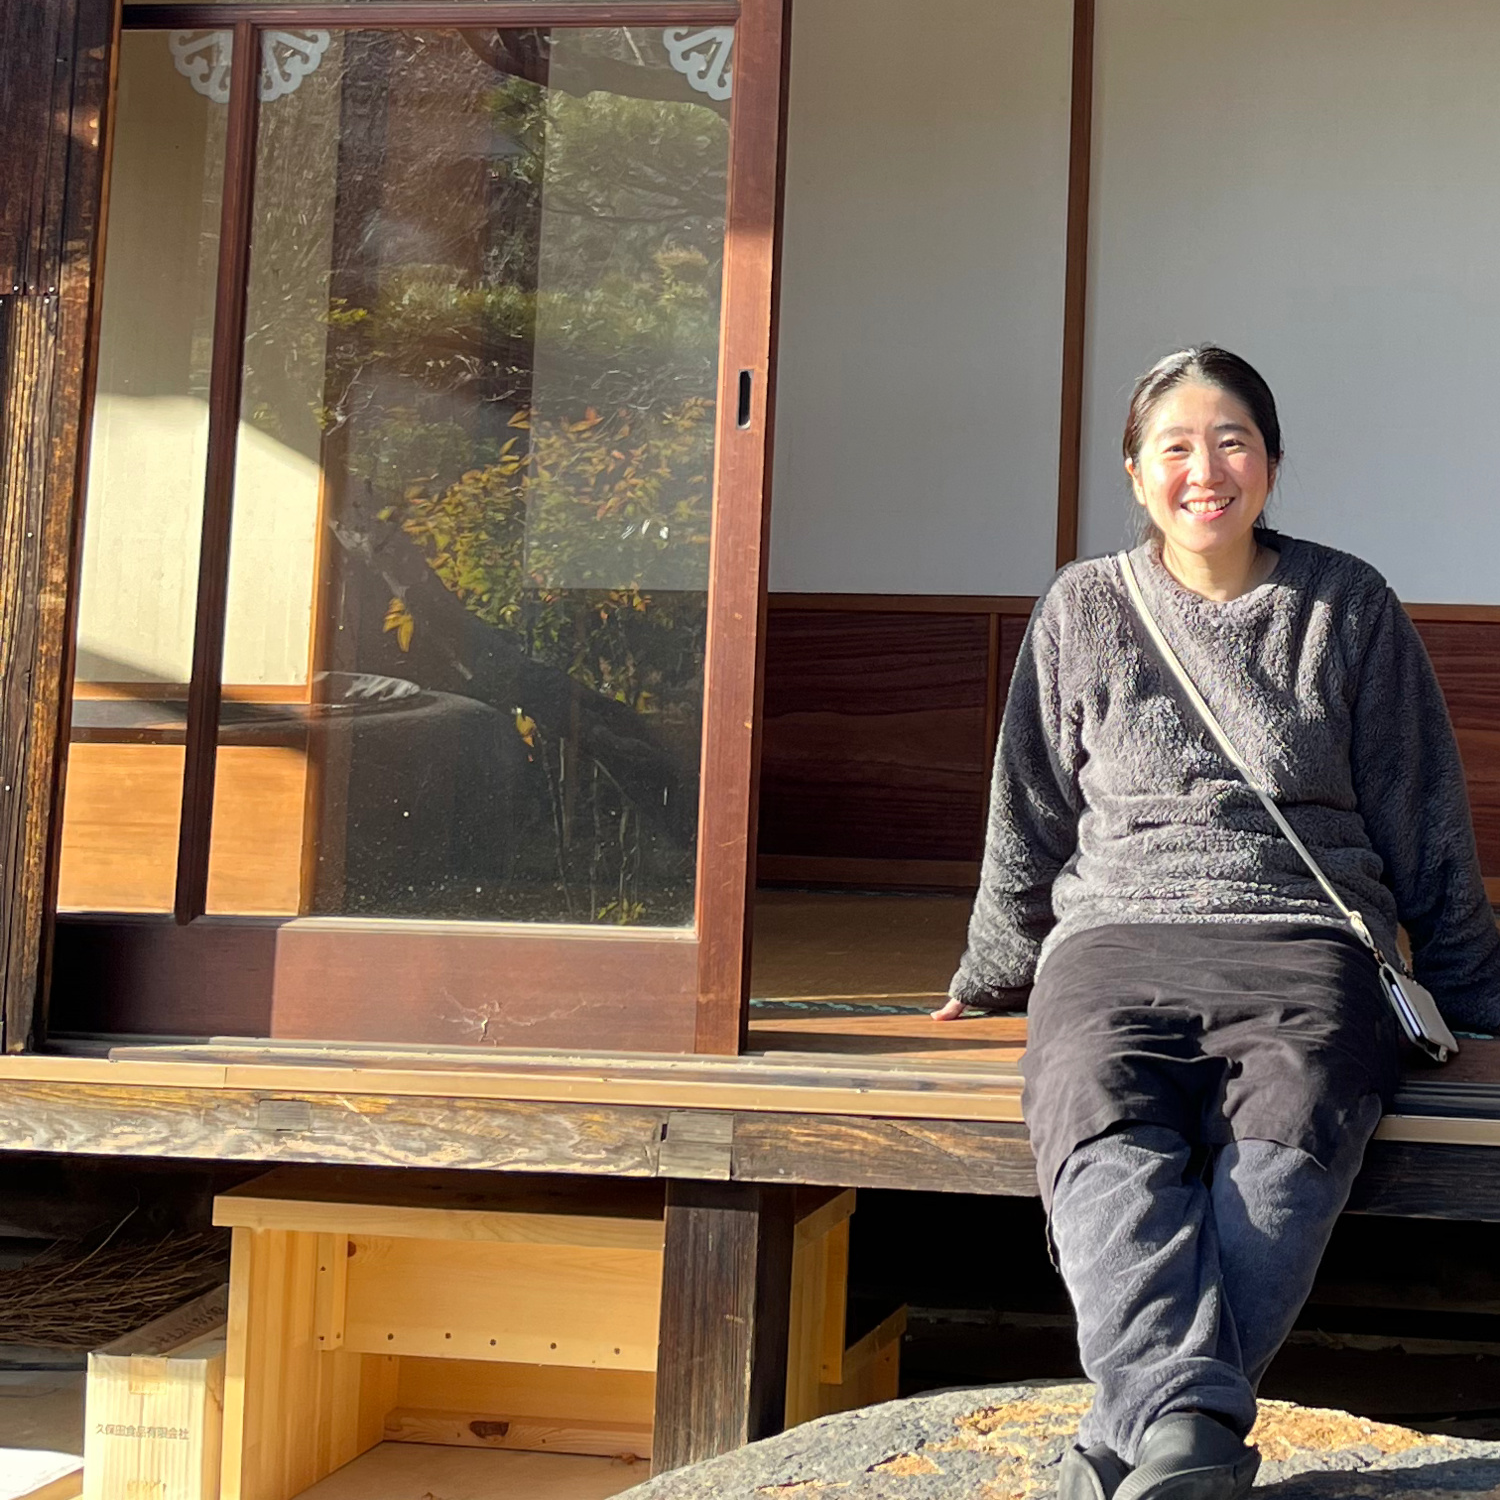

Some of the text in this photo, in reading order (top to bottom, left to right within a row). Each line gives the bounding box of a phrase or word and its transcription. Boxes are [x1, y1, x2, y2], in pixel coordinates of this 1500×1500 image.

[96, 1424, 189, 1440] 久保田食品有限会社
